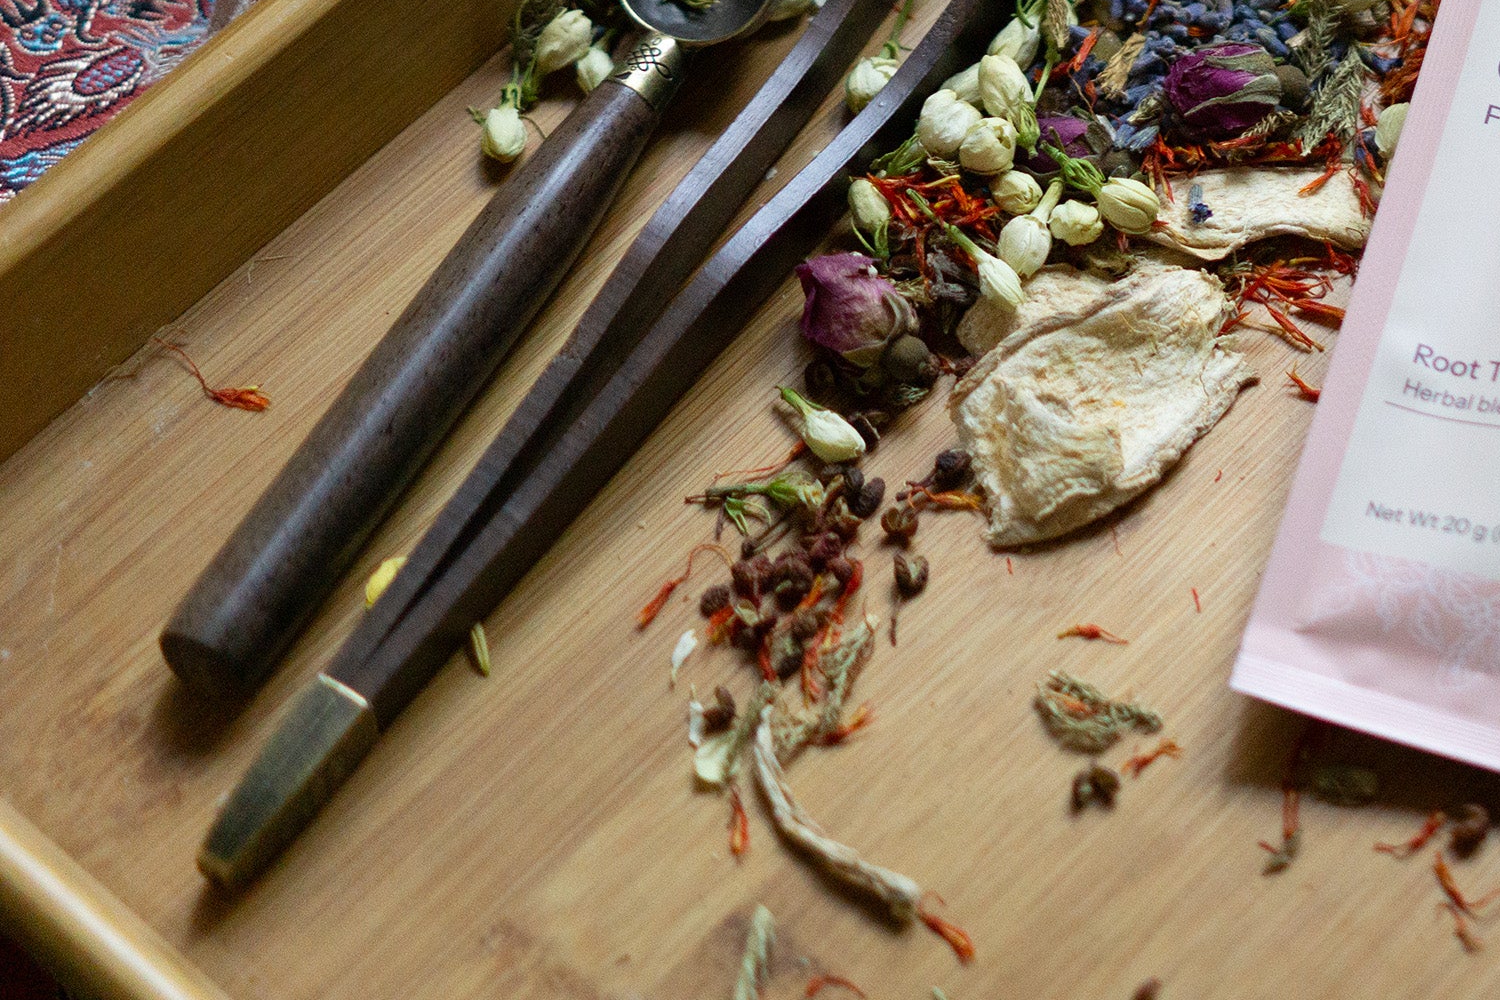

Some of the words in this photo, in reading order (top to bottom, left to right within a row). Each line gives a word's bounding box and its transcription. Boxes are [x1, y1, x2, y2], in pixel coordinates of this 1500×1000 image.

[1413, 342, 1480, 381] Root
[1402, 377, 1474, 411] Herbal
[1365, 500, 1403, 523] Net
[1441, 515, 1471, 535] 20
[1471, 524, 1488, 544] g
